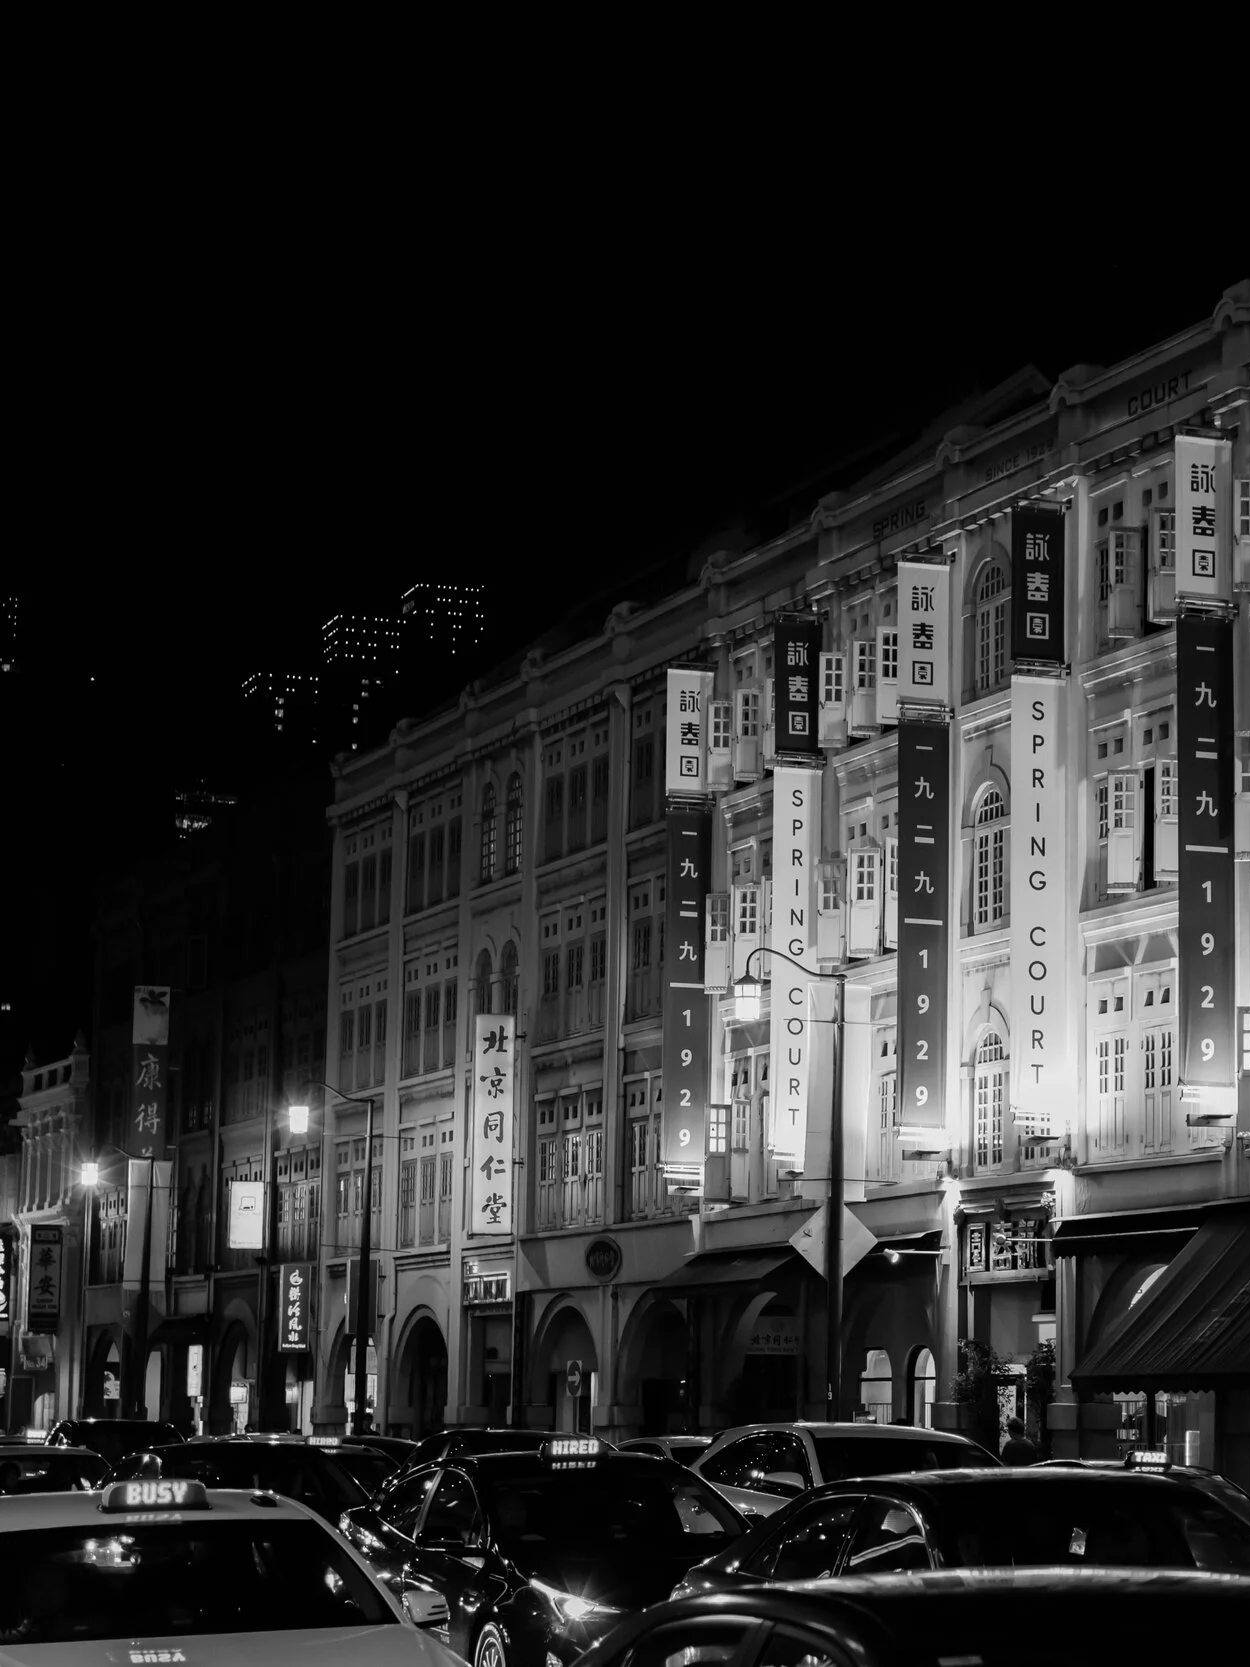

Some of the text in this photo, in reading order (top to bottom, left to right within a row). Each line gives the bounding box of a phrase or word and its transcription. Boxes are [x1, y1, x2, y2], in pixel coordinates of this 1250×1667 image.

[1127, 371, 1192, 417] COURT
[985, 438, 1055, 482] SINCE 1929
[872, 502, 928, 540] SPRING
[1028, 700, 1047, 1085] SPRING COURT
[786, 789, 805, 1127] SPRING COURT
[1198, 880, 1216, 1062] 1929
[915, 949, 931, 1107] 1929
[135, 1053, 162, 1157] 康得
[679, 1009, 693, 1147] 1929
[480, 1025, 509, 1225] 北京同仁堂
[36, 1356, 46, 1369] 34
[552, 1439, 599, 1455] HIRED
[1134, 1451, 1167, 1464] TAXI
[126, 1482, 187, 1504] BUSY
